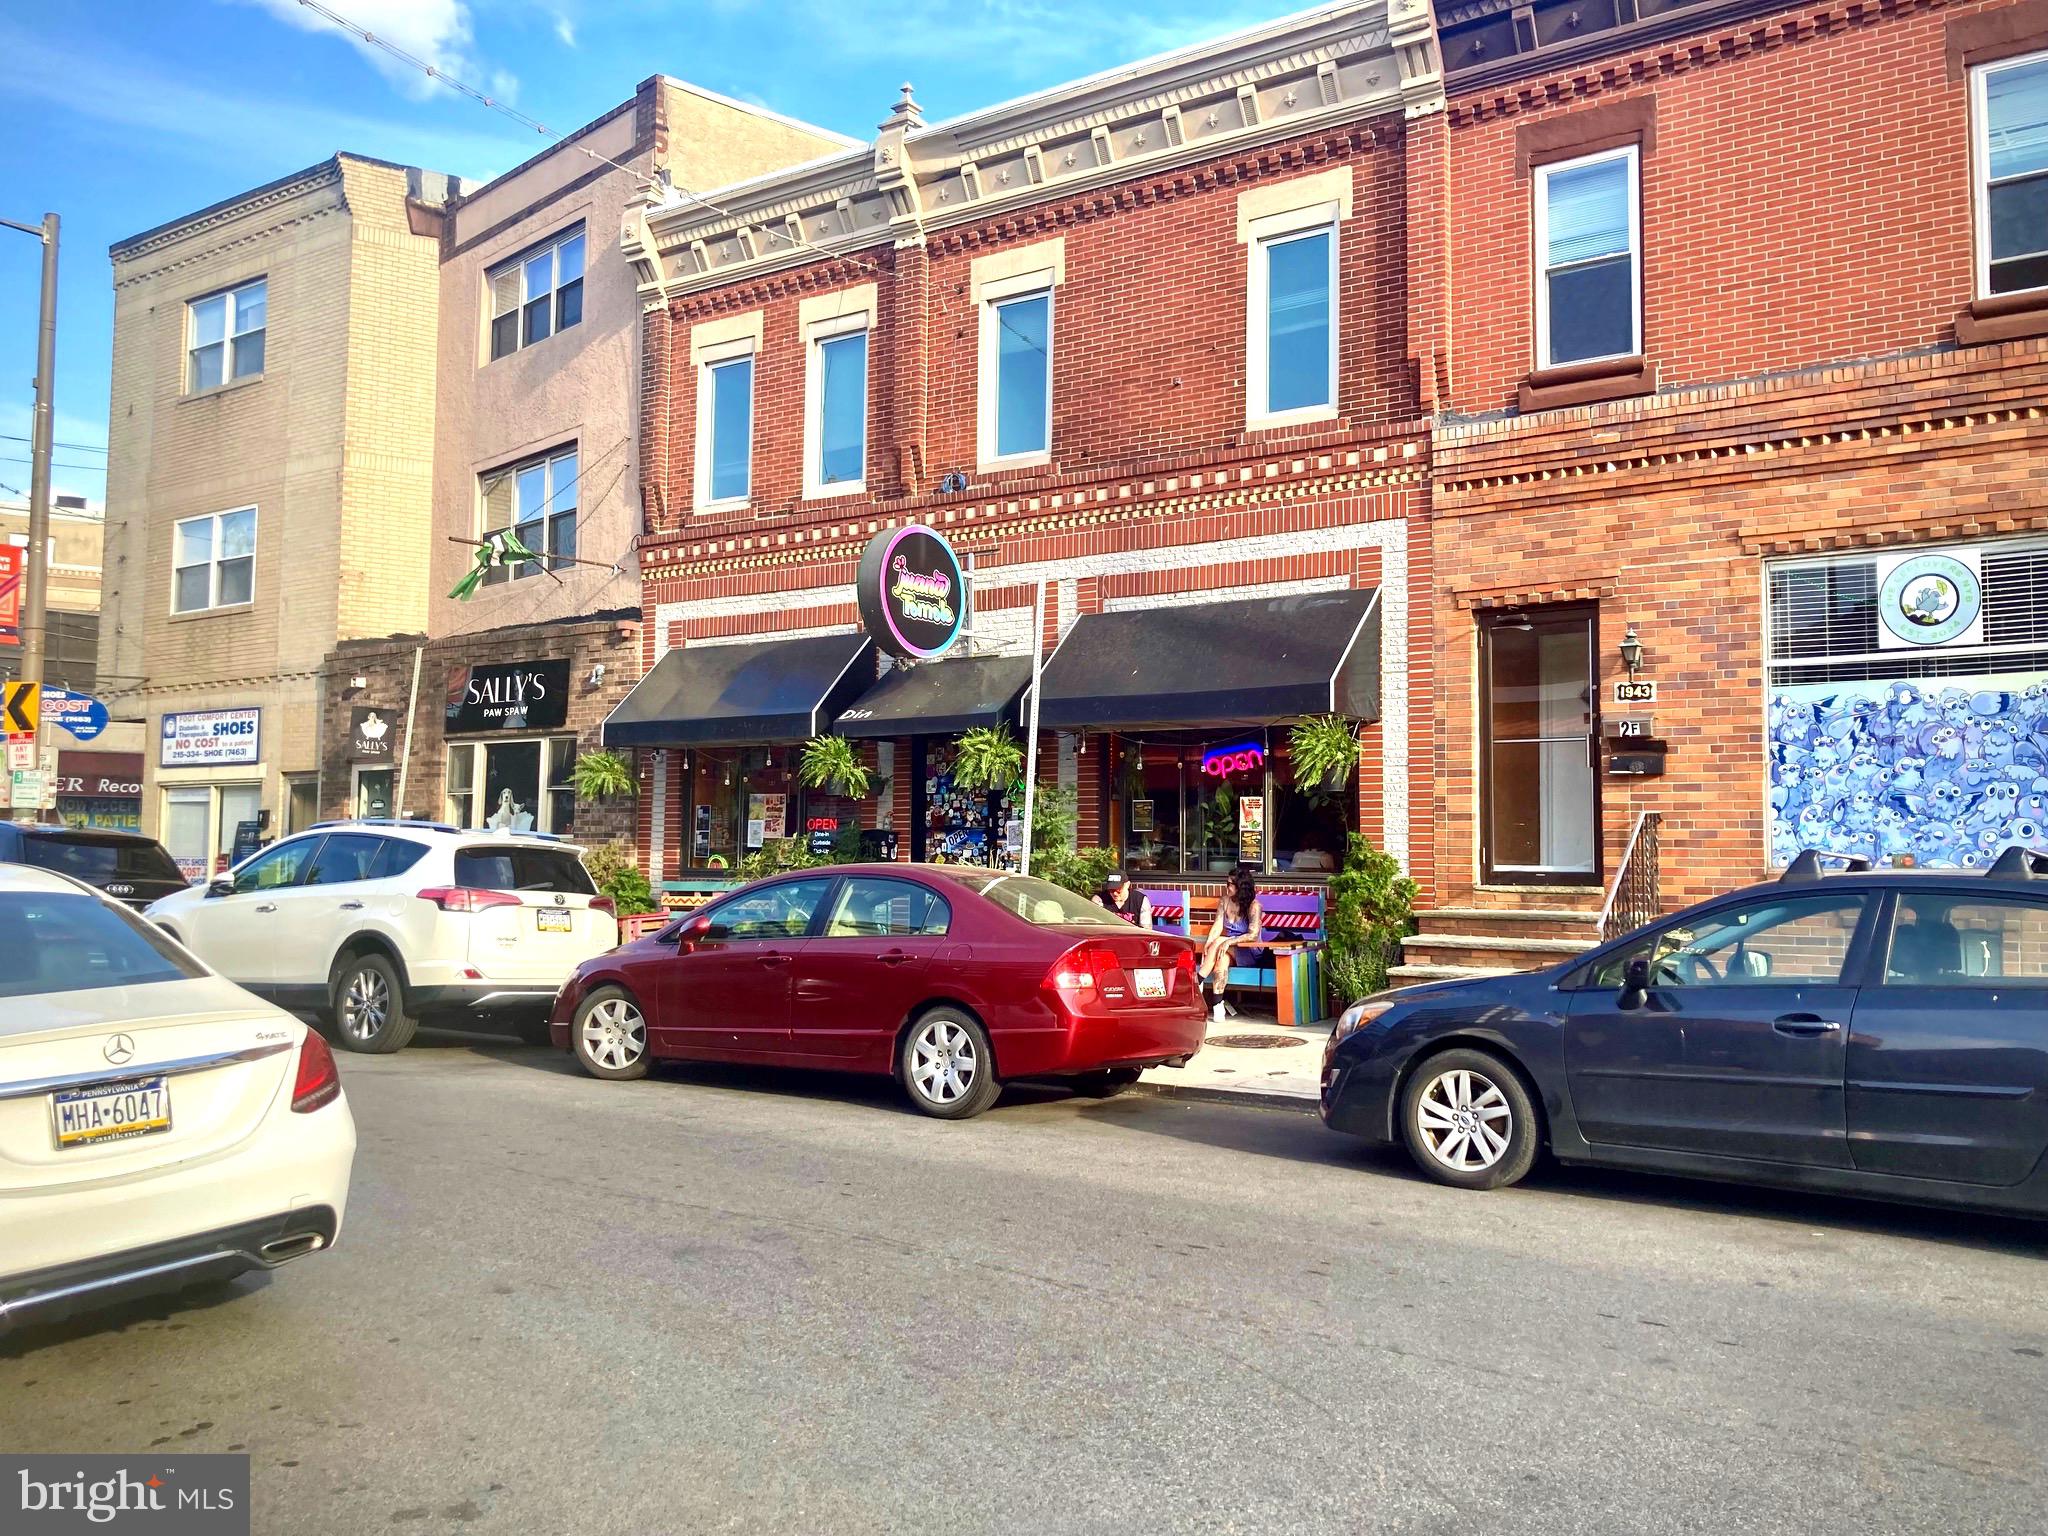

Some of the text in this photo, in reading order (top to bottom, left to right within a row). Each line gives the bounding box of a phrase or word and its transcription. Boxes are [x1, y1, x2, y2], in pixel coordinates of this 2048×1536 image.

[468, 672, 546, 705] SALLY'S
[1620, 686, 1650, 698] 1943
[41, 699, 94, 713] COST
[483, 705, 529, 718] PAW SPAW
[179, 711, 257, 722] FOOT COMFORT CENTER
[212, 720, 254, 736] SHOES
[15, 745, 28, 753] ANY
[175, 739, 191, 750] NO
[194, 737, 220, 749] COST
[234, 739, 254, 748] patient
[356, 740, 388, 751] SALLY'S
[204, 749, 223, 758] SHOE
[225, 747, 247, 758] (7463)
[1207, 750, 1263, 779] open
[807, 818, 838, 830] OPEN
[82, 1083, 139, 1098] PENNSYLVANIA
[86, 1129, 147, 1144] Faulkner
